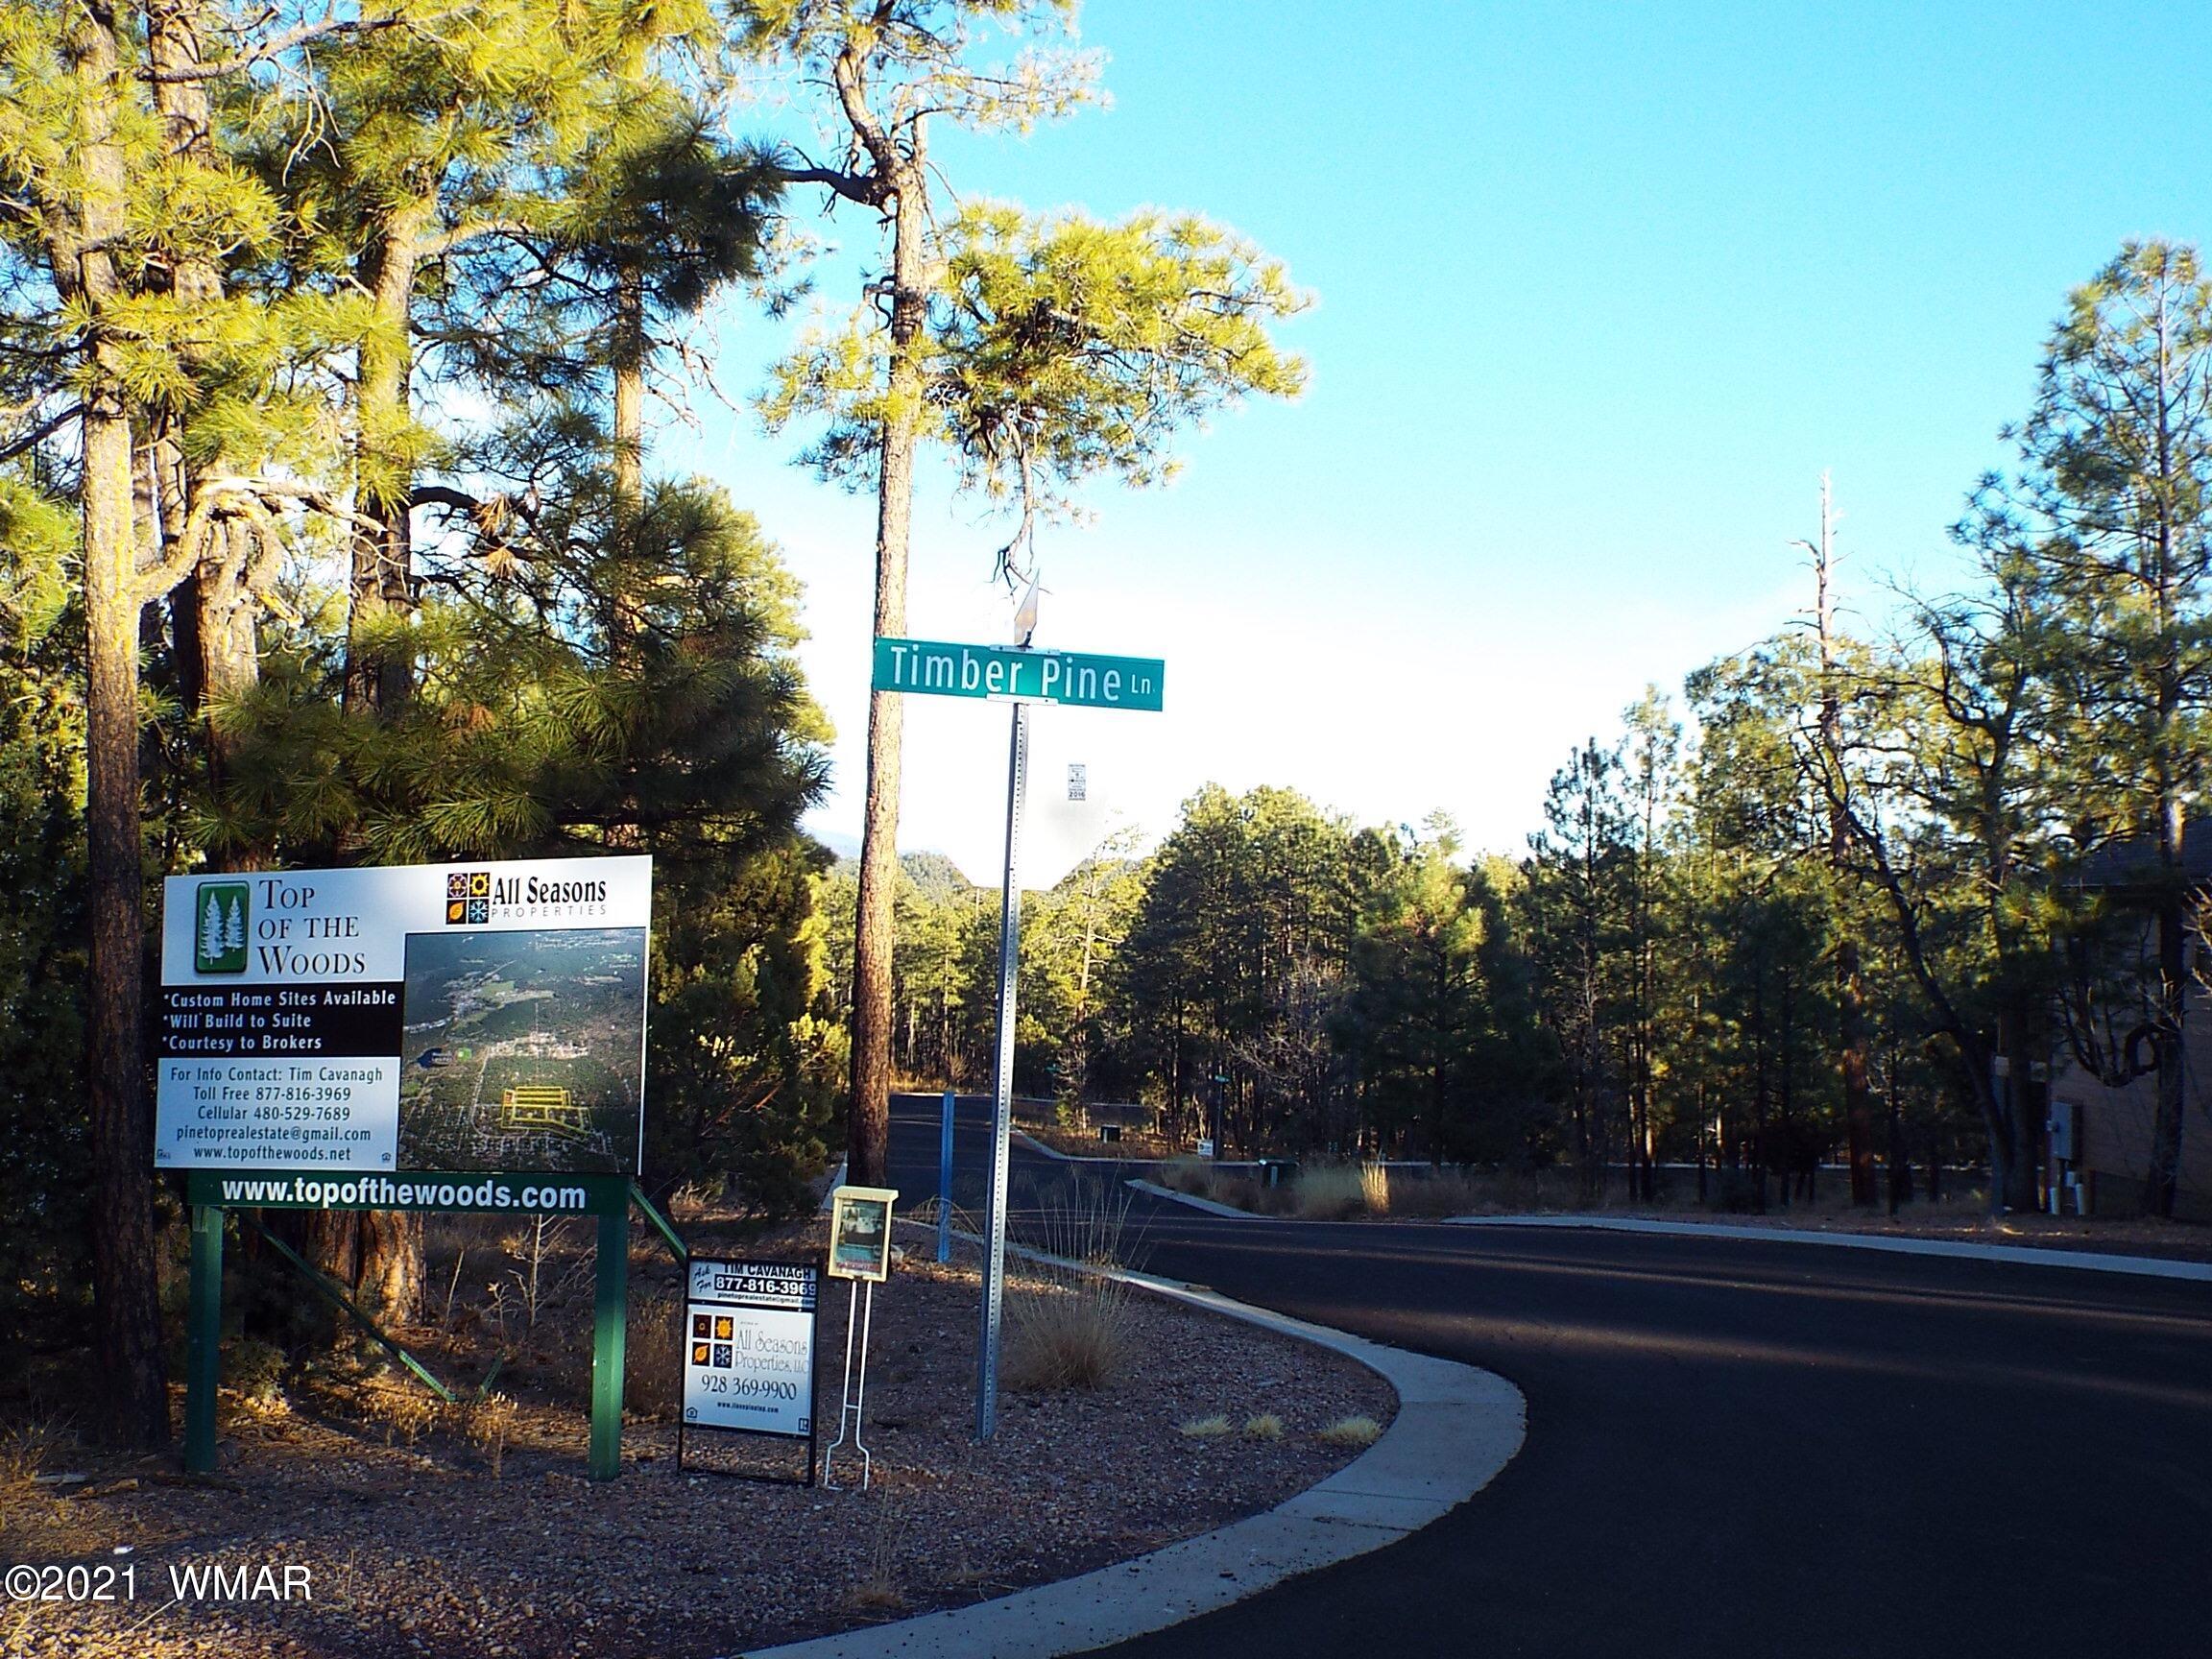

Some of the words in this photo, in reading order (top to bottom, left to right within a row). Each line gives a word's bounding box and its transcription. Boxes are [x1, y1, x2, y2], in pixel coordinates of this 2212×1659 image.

[891, 645, 1022, 694] Timber
[1042, 656, 1121, 702] Pine
[493, 878, 522, 905] All
[527, 876, 607, 904] Seasons
[492, 904, 607, 918] PROPERTIES
[258, 919, 292, 940] OF
[304, 916, 360, 938] THE
[231, 992, 272, 1007] Home
[279, 991, 317, 1006] Sites
[324, 990, 397, 1005] Available
[205, 1013, 244, 1028] Build
[251, 1015, 265, 1028] to
[272, 1013, 311, 1028] Suite
[241, 1037, 255, 1049] to
[262, 1034, 323, 1049] Brokers
[171, 1067, 191, 1081] For
[197, 1067, 222, 1081] Info
[228, 1067, 282, 1081] Contact:
[289, 1067, 312, 1081] Tim
[319, 1067, 383, 1085] Cavanagh
[193, 1086, 216, 1100] Toll
[223, 1087, 250, 1100] Free
[255, 1087, 351, 1101] 877-816-3969
[198, 1105, 248, 1120] Cellular
[253, 1106, 350, 1121] 480-529-7689
[177, 1125, 372, 1142] pinetoprealestate@gmail.com
[194, 1145, 351, 1162] www.topofthewoods.net
[222, 1177, 587, 1210] www.topofthewoods.com
[723, 1263, 744, 1275] TIM
[747, 1264, 811, 1281] CAVANAGH
[715, 1276, 816, 1296] 877-816-3969
[736, 1329, 752, 1350] All
[755, 1331, 808, 1356] Seasons
[701, 1374, 728, 1392] 928
[733, 1377, 797, 1401] 369-9900
